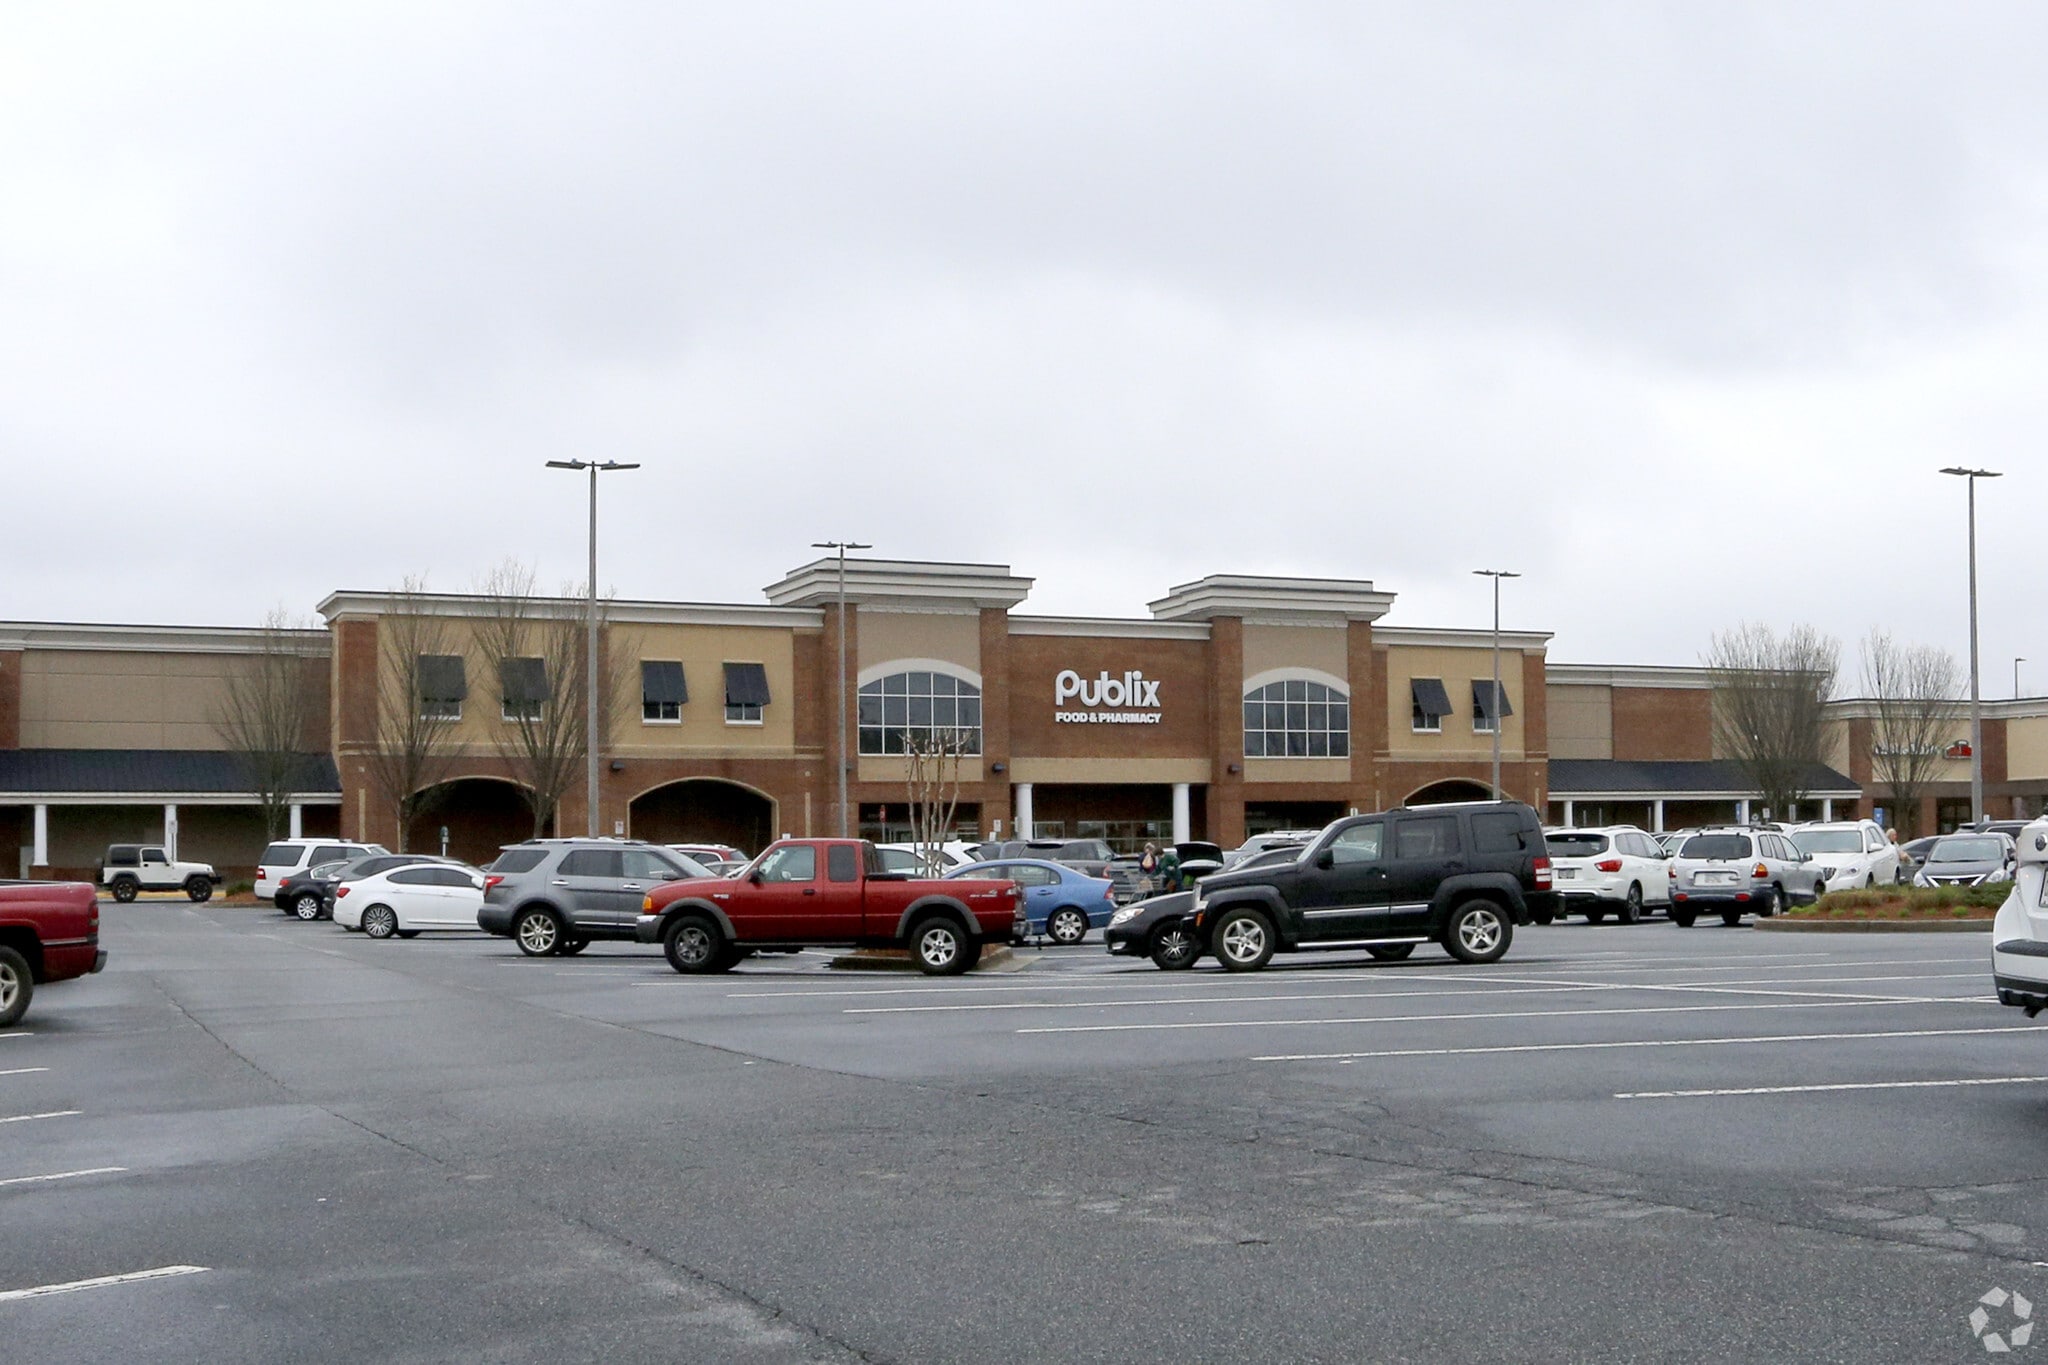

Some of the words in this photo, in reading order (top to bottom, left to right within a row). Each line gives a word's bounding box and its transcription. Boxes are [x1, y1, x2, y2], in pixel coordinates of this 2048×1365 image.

[1055, 670, 1161, 707] Publix
[1055, 711, 1088, 723] FOOD
[1089, 711, 1098, 723] &
[1098, 712, 1162, 724] PHARMACY
